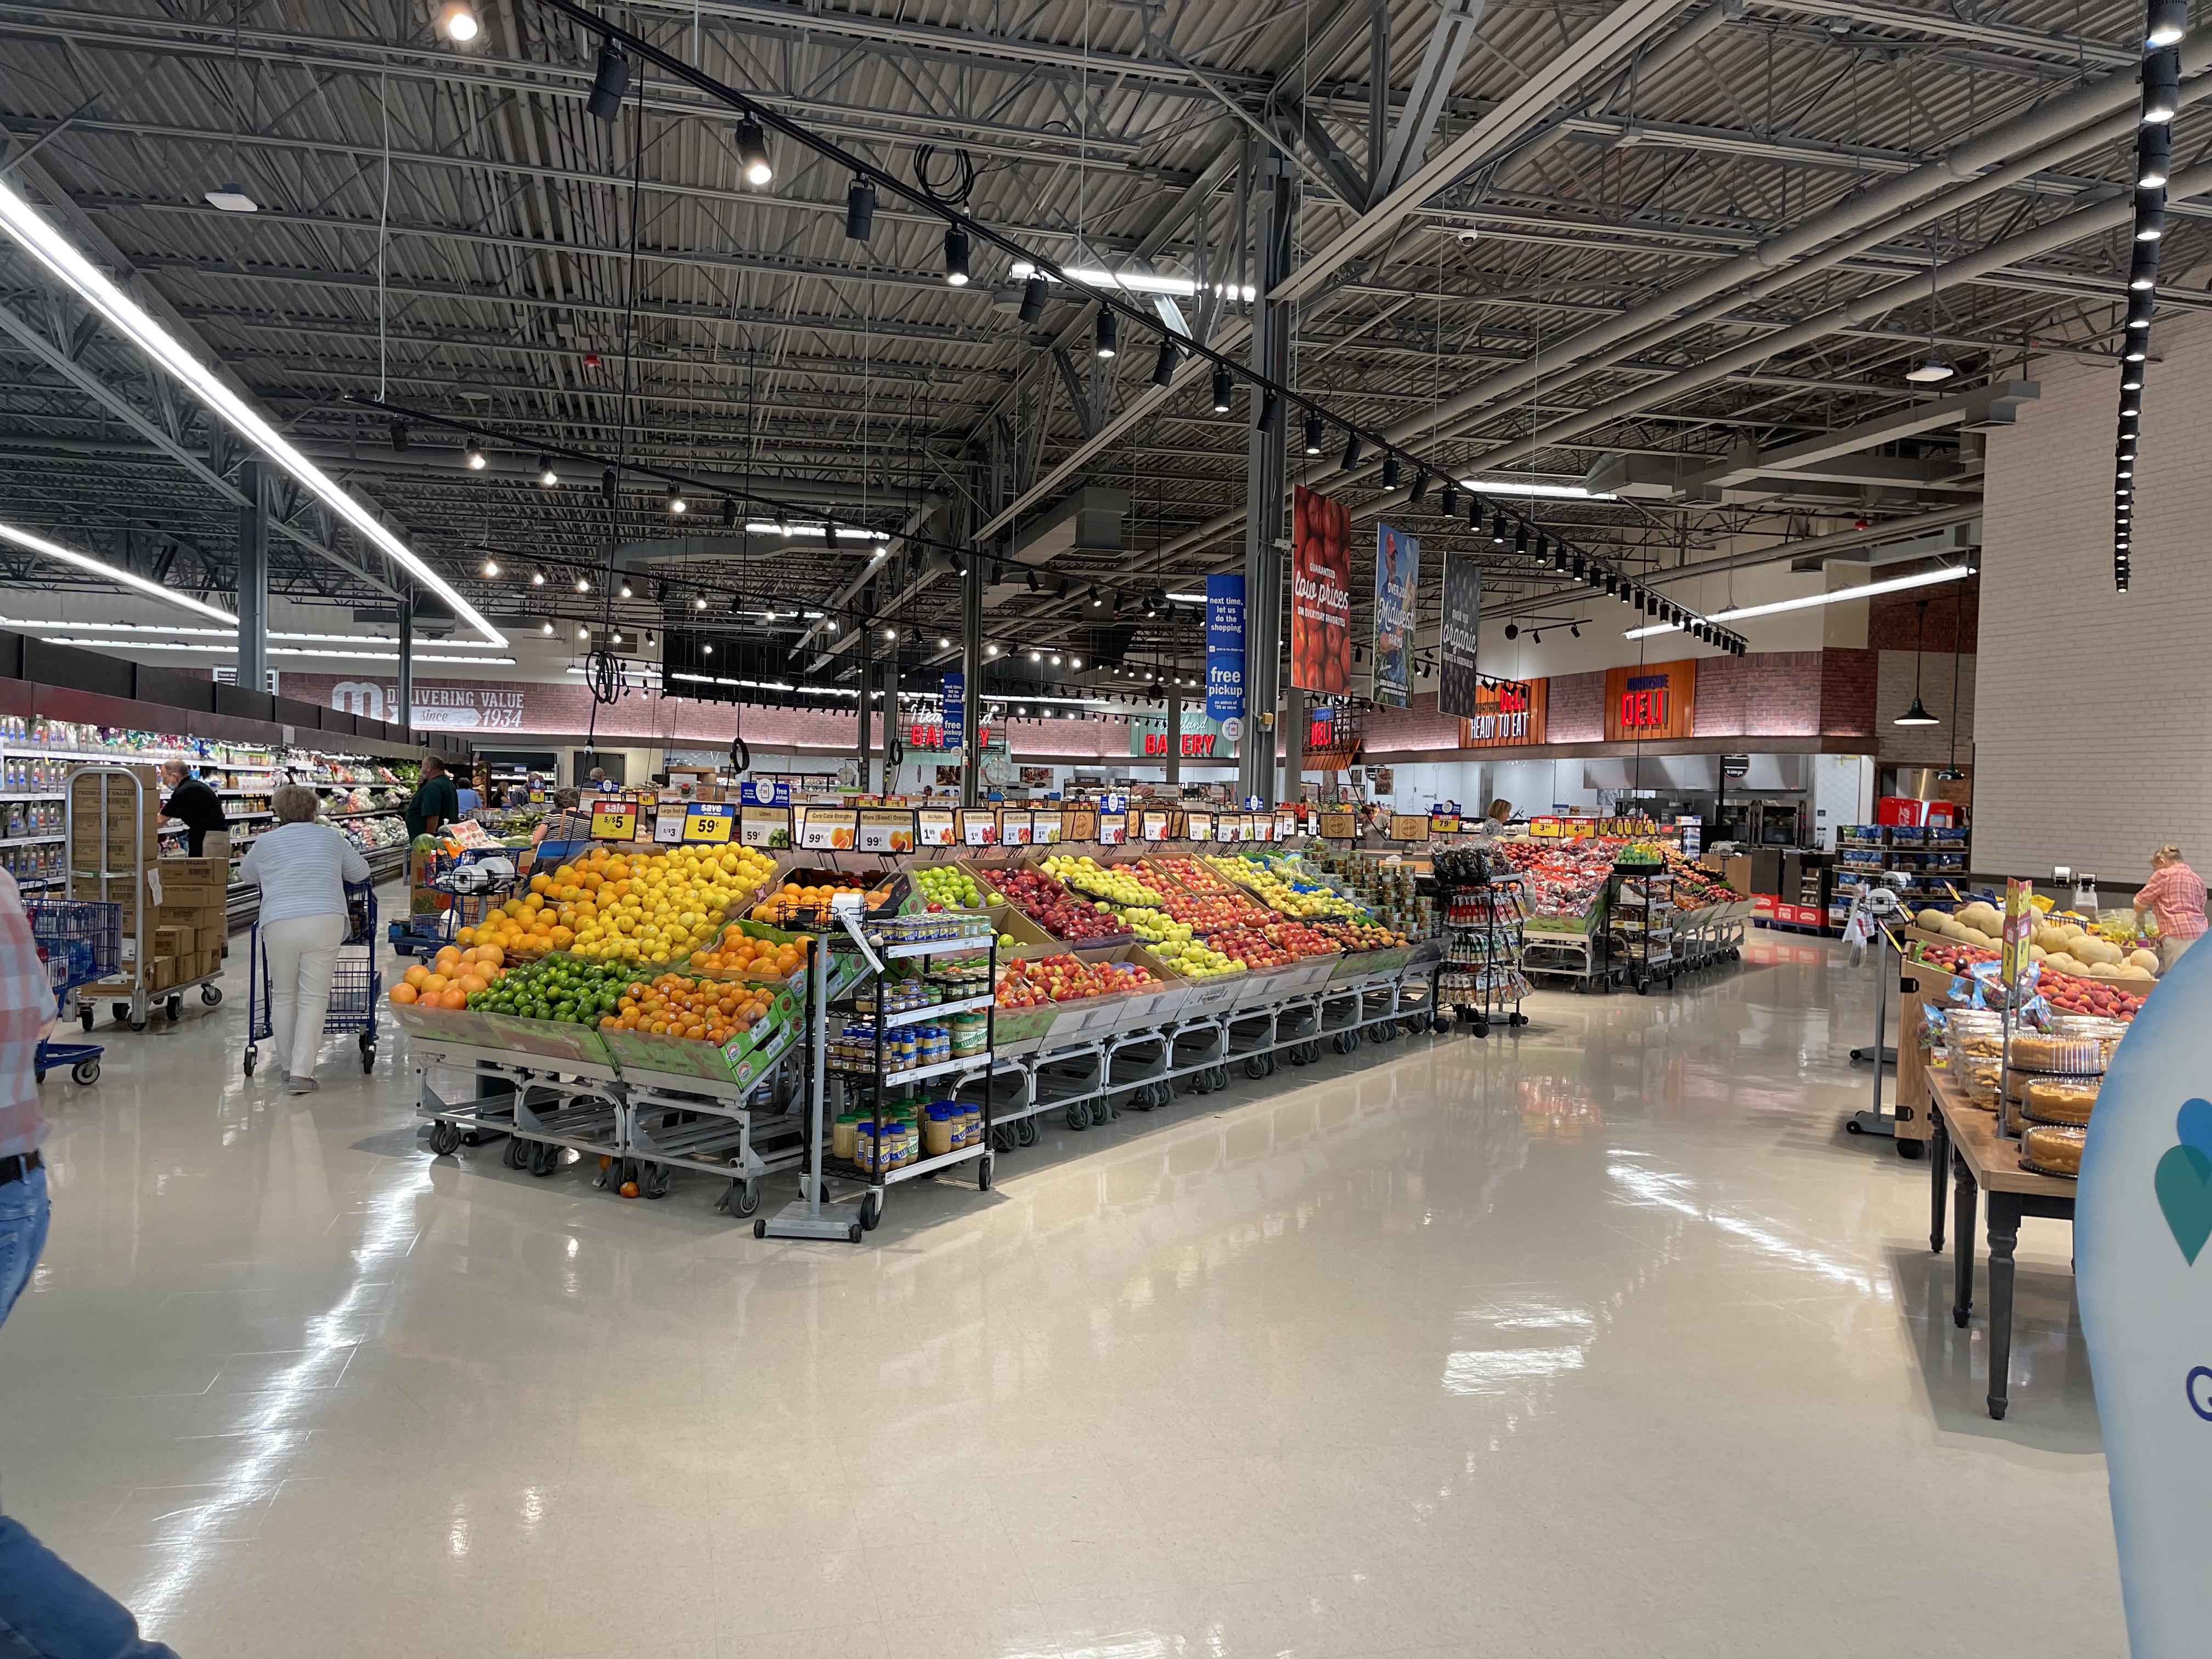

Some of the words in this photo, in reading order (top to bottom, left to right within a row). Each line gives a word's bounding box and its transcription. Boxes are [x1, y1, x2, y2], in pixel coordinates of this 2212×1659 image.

[1310, 563, 1336, 579] GUARANTEED
[1295, 571, 1317, 600] low
[1317, 582, 1349, 610] prices
[1388, 582, 1399, 596] OVER
[1226, 597, 1243, 606] time,
[1297, 606, 1304, 616] ON
[1305, 607, 1325, 622] EVERYDAY
[1325, 613, 1345, 628] FAVORITES
[1378, 597, 1414, 631] Midwest
[1211, 623, 1242, 633] shopping
[1389, 633, 1403, 648] FARMS
[1443, 623, 1477, 654] organic
[1211, 666, 1241, 683] free
[1209, 684, 1243, 697] pickup
[387, 688, 474, 707] DIVERING
[481, 692, 524, 708] VALUE
[420, 709, 448, 722] since
[1621, 690, 1663, 727] DELI
[483, 708, 523, 727] 1934
[944, 720, 961, 729] free
[1471, 715, 1496, 739] READY
[1499, 713, 1509, 738] TO
[1513, 712, 1528, 737] EAT
[1311, 721, 1331, 746] DELI
[1146, 734, 1215, 754] BAERY
[604, 803, 627, 813] sale
[701, 804, 723, 813] save
[604, 816, 624, 828] 5/$5
[697, 819, 720, 833] 59¢
[747, 831, 761, 840] 59¢
[809, 834, 824, 843] 99¢
[867, 837, 882, 847] 99¢
